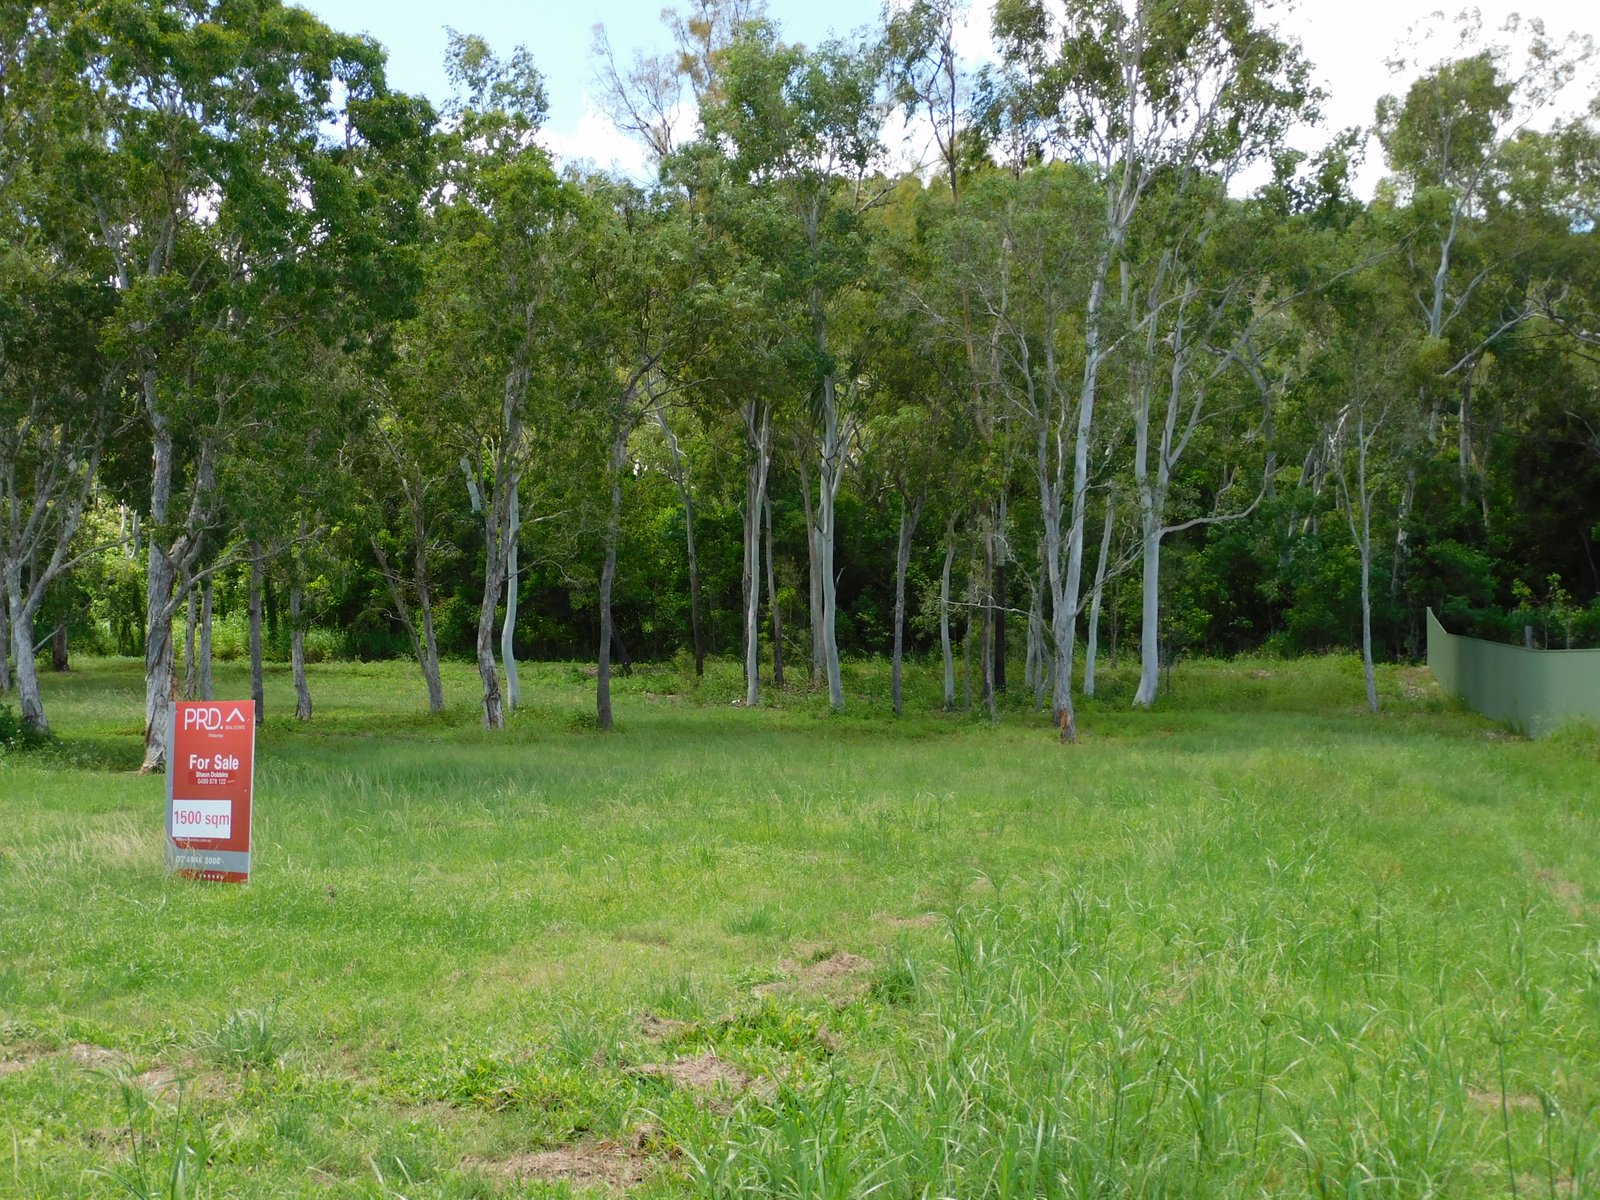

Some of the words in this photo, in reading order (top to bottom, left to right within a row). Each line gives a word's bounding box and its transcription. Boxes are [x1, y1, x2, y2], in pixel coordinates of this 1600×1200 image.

[189, 754, 210, 770] For
[214, 754, 239, 770] Sale
[174, 810, 202, 824] 1500
[205, 814, 230, 828] sqm
[205, 856, 221, 865] 2000
